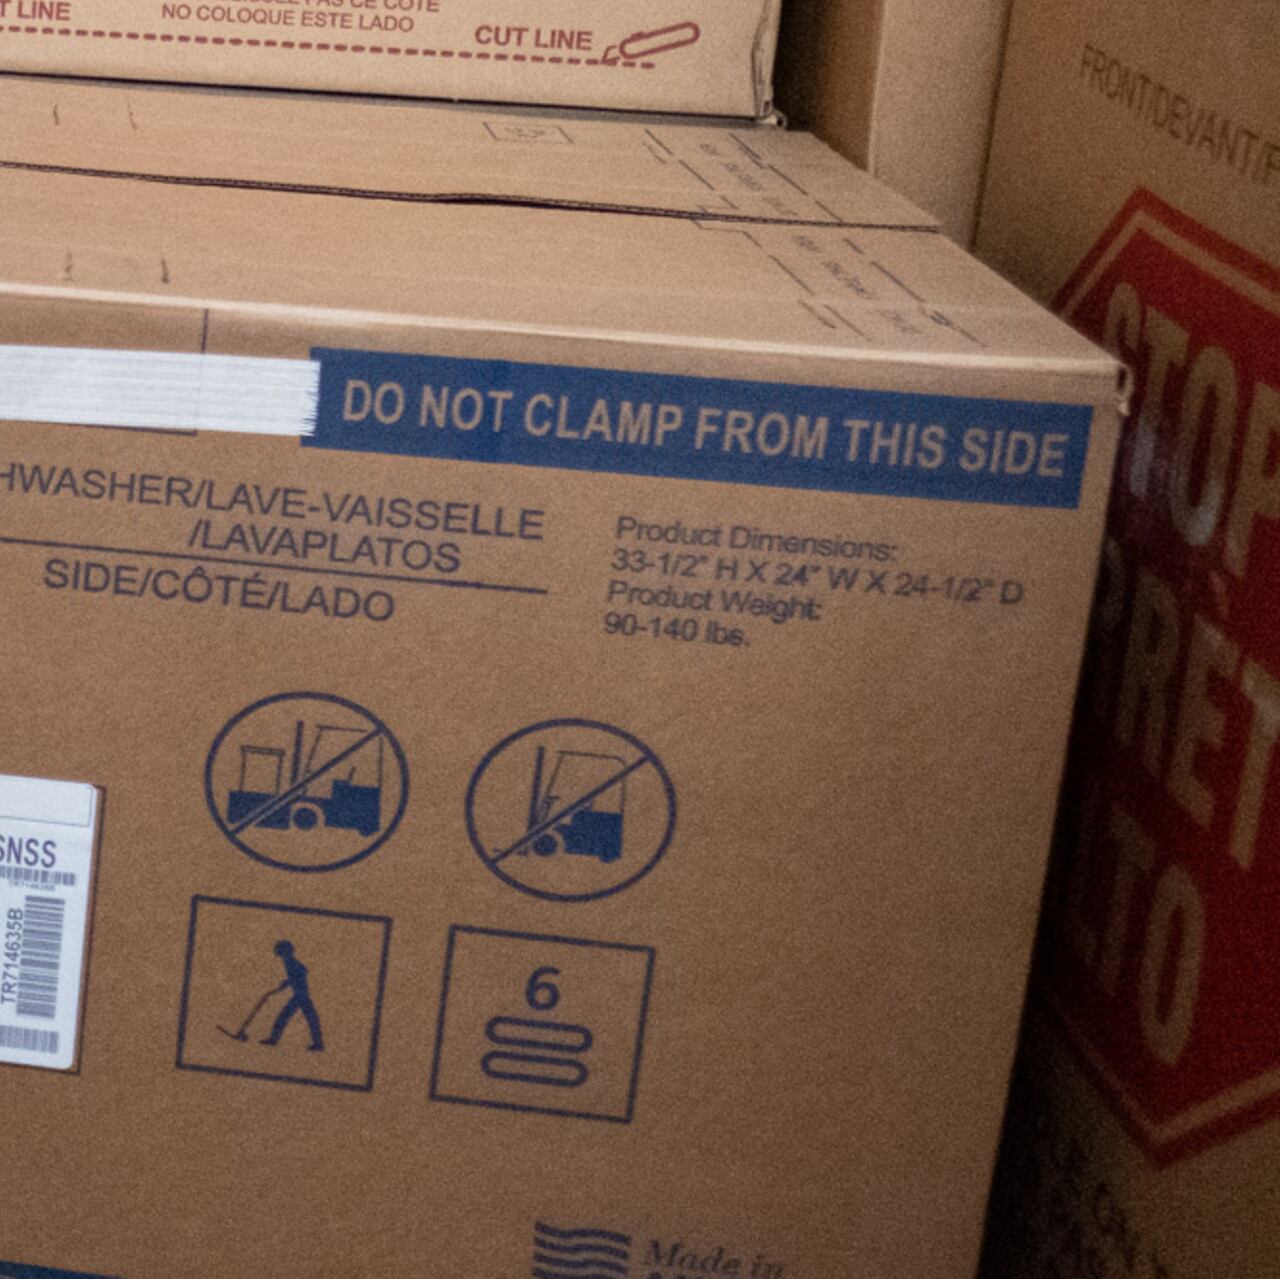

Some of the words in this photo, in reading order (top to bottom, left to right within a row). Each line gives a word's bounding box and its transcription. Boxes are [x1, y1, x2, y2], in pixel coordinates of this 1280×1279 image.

[161, 4, 192, 21] NO
[196, 5, 300, 27] COLOQUE
[302, 9, 355, 30] ESTE
[357, 12, 416, 34] LADO
[474, 24, 530, 48] CUT
[535, 27, 594, 52] LINE
[342, 378, 405, 424] DO
[417, 383, 513, 433] NOT
[522, 392, 684, 449] CLAMP
[693, 406, 831, 461] FROM
[844, 418, 949, 472] THIS
[959, 427, 1070, 479] SIDE
[186, 517, 464, 574] /LAVAPLATOS
[616, 515, 722, 549] Product
[729, 524, 900, 563] Dimensions:
[44, 554, 397, 624] SIDE/CÔTÉ/LADO
[606, 579, 714, 613] Product
[719, 588, 824, 625] Weight:
[715, 559, 739, 582] H
[743, 559, 768, 583] X
[827, 567, 863, 591] W
[866, 569, 889, 593] X
[999, 581, 1024, 606] D
[603, 610, 700, 644] 90-140
[704, 616, 750, 649] lbs.
[0, 906, 25, 1006] TR714635B
[525, 966, 561, 1014] 6
